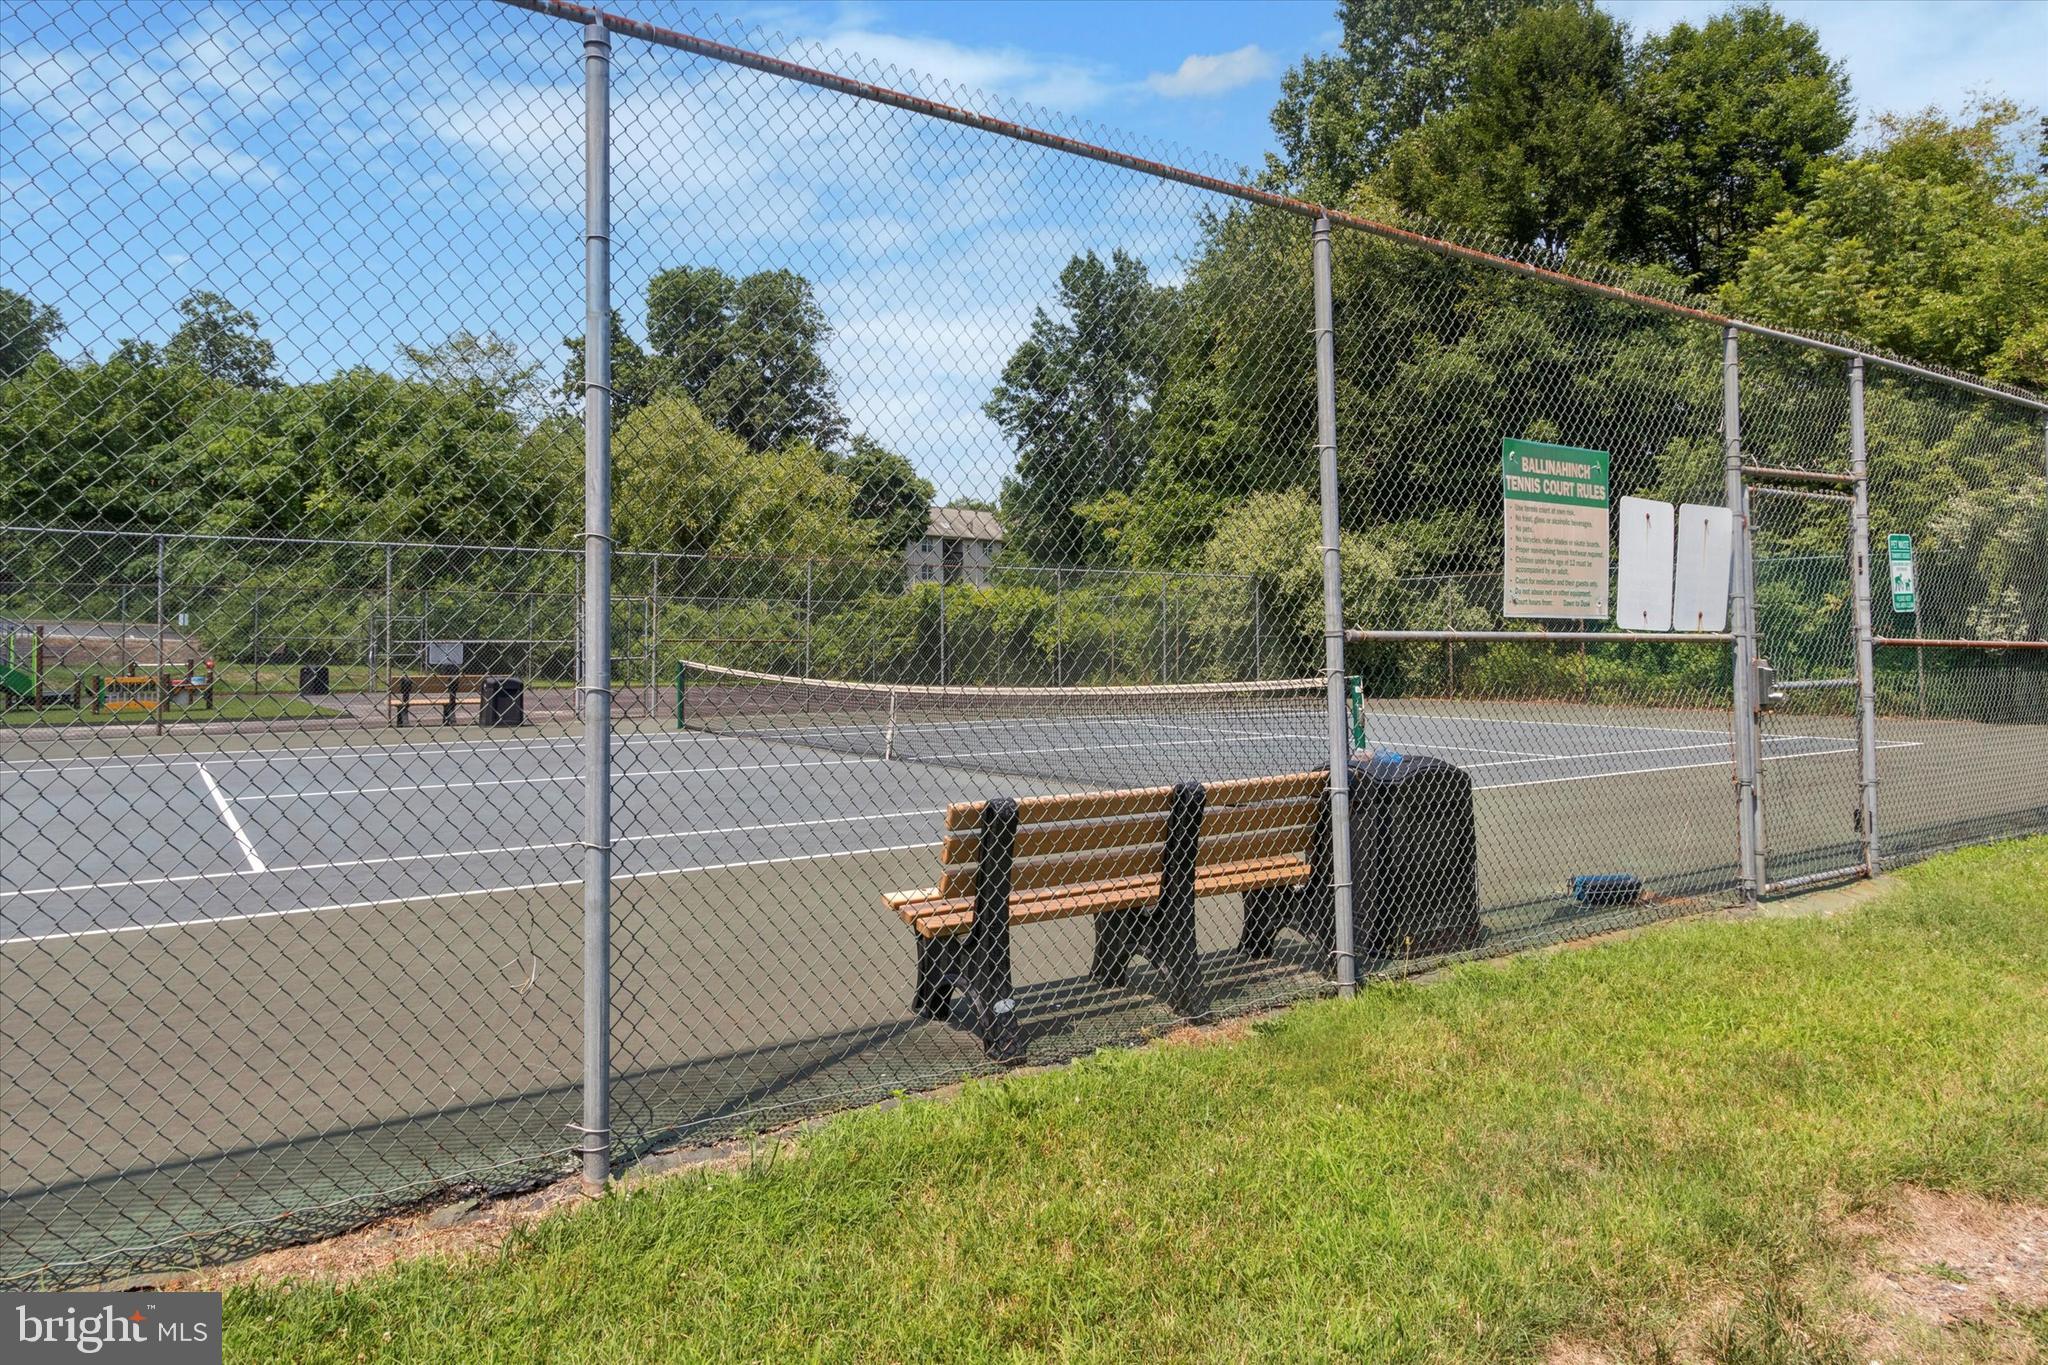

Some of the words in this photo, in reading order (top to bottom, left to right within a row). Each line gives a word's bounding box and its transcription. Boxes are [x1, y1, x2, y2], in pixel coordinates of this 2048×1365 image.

[1521, 456, 1591, 480] BALLINAHINCH
[1505, 475, 1541, 494] TENNIS
[1543, 479, 1575, 497] COURT
[1577, 483, 1606, 501] RULES
